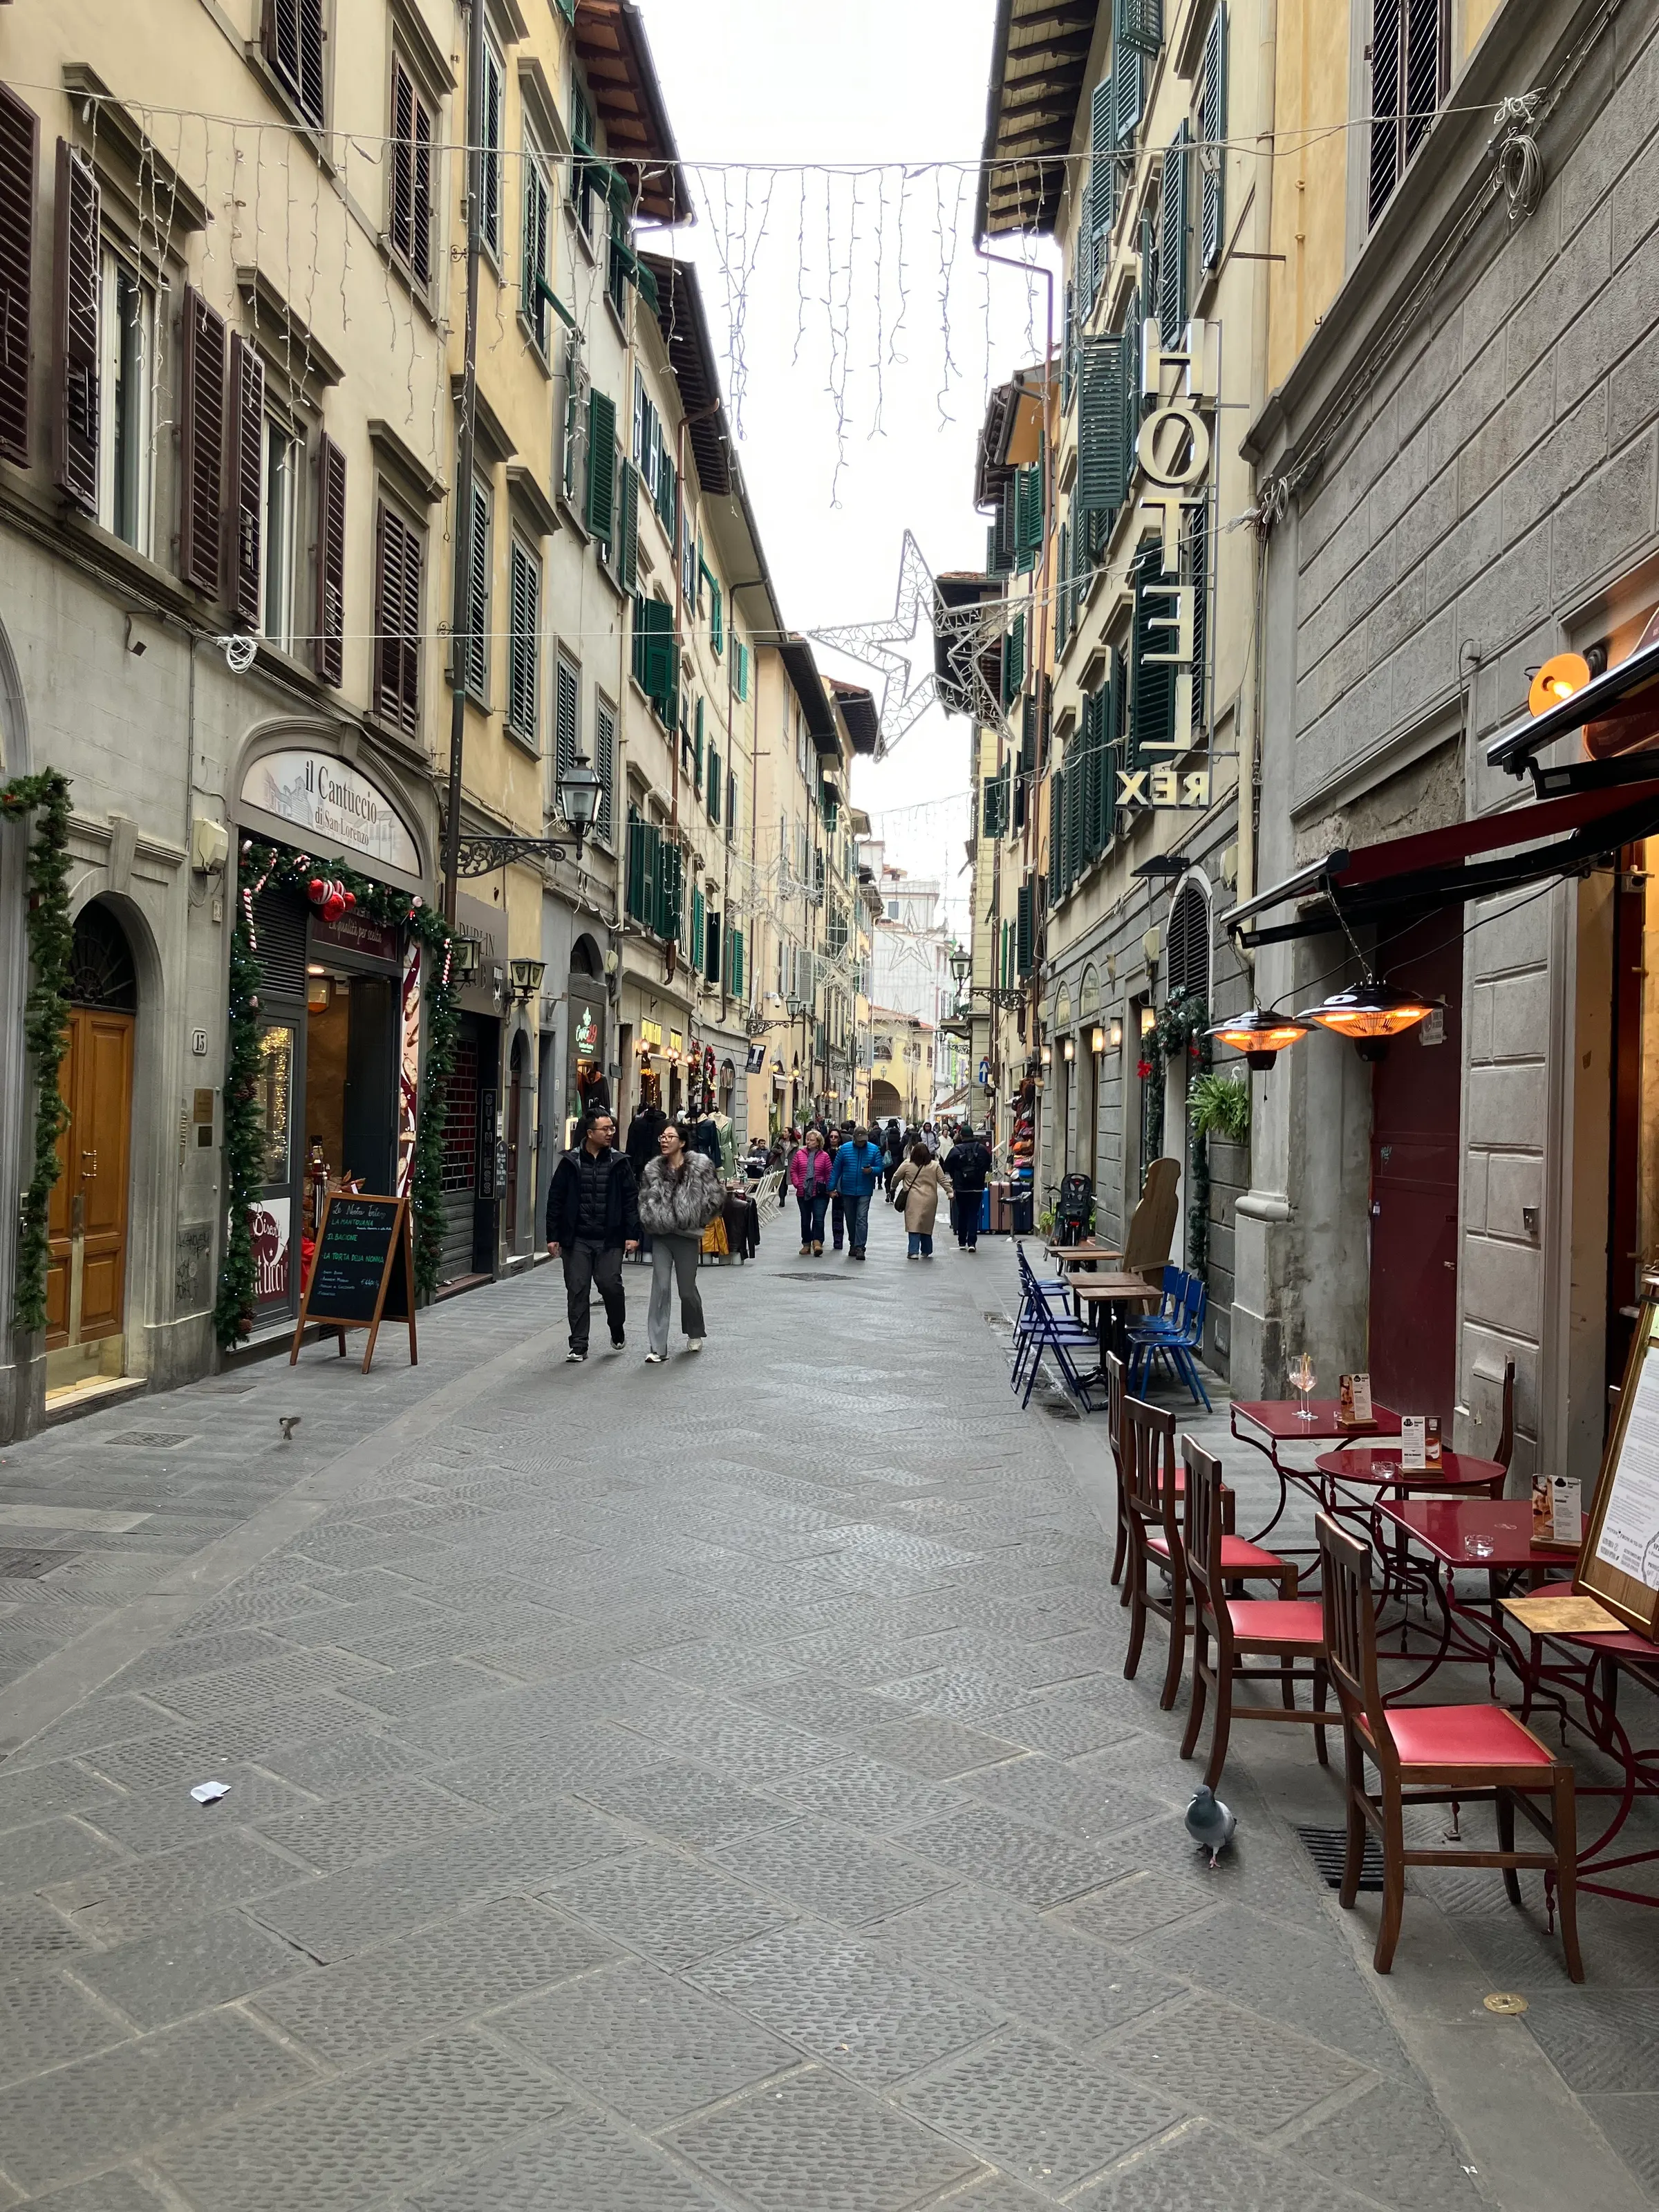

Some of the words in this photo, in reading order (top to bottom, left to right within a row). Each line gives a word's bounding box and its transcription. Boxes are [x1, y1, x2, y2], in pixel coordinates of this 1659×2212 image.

[306, 760, 314, 793] il
[318, 766, 377, 824] Cantuccio
[315, 807, 326, 825] di
[325, 810, 339, 832] San
[340, 818, 368, 845] Lorenzo
[484, 1094, 493, 1194] GUINNESS
[332, 1253, 349, 1261] TORTA
[365, 1255, 384, 1264] NONNA
